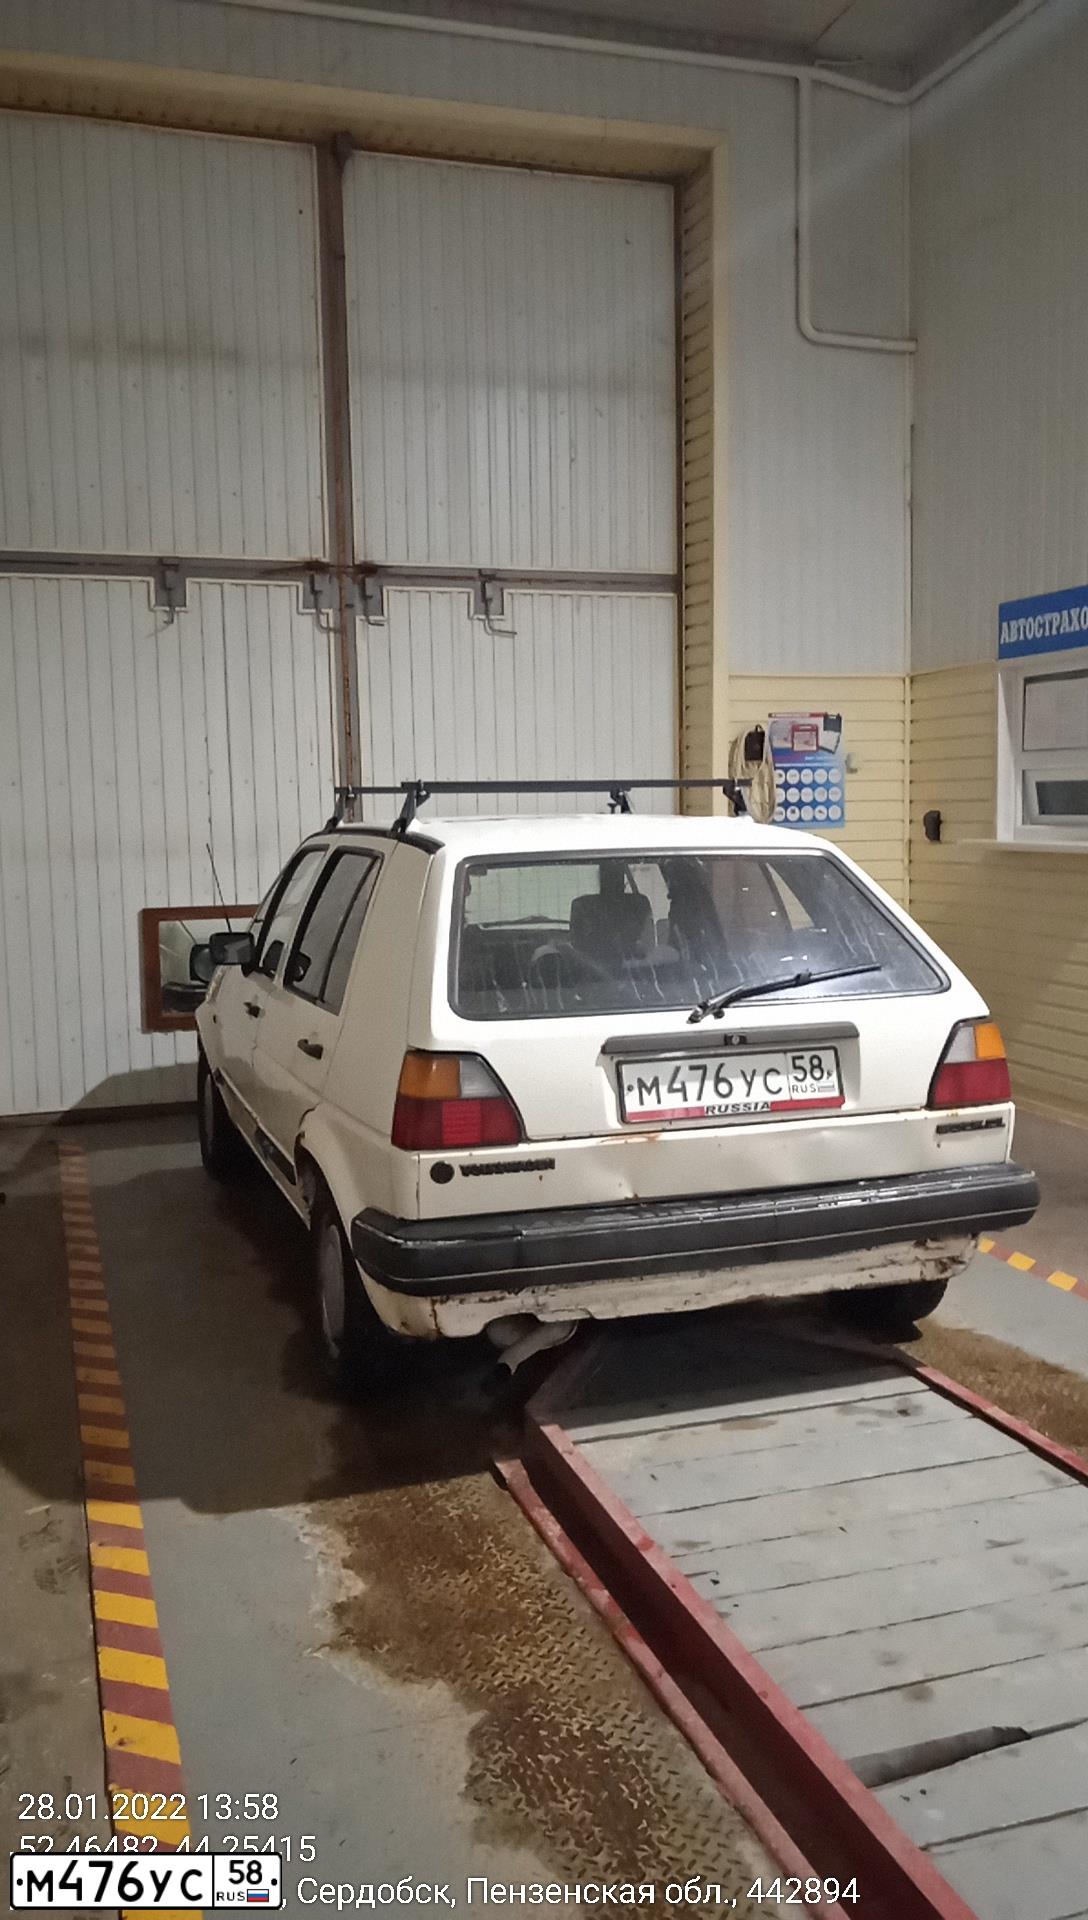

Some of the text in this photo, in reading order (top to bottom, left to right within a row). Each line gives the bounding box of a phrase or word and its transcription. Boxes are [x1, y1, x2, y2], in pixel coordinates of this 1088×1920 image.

[1000, 605, 1088, 645] АВТОСТРАХО
[636, 1054, 824, 1106] М476УС 58
[791, 1084, 817, 1093] RUS
[705, 1102, 770, 1115] RUSSIA
